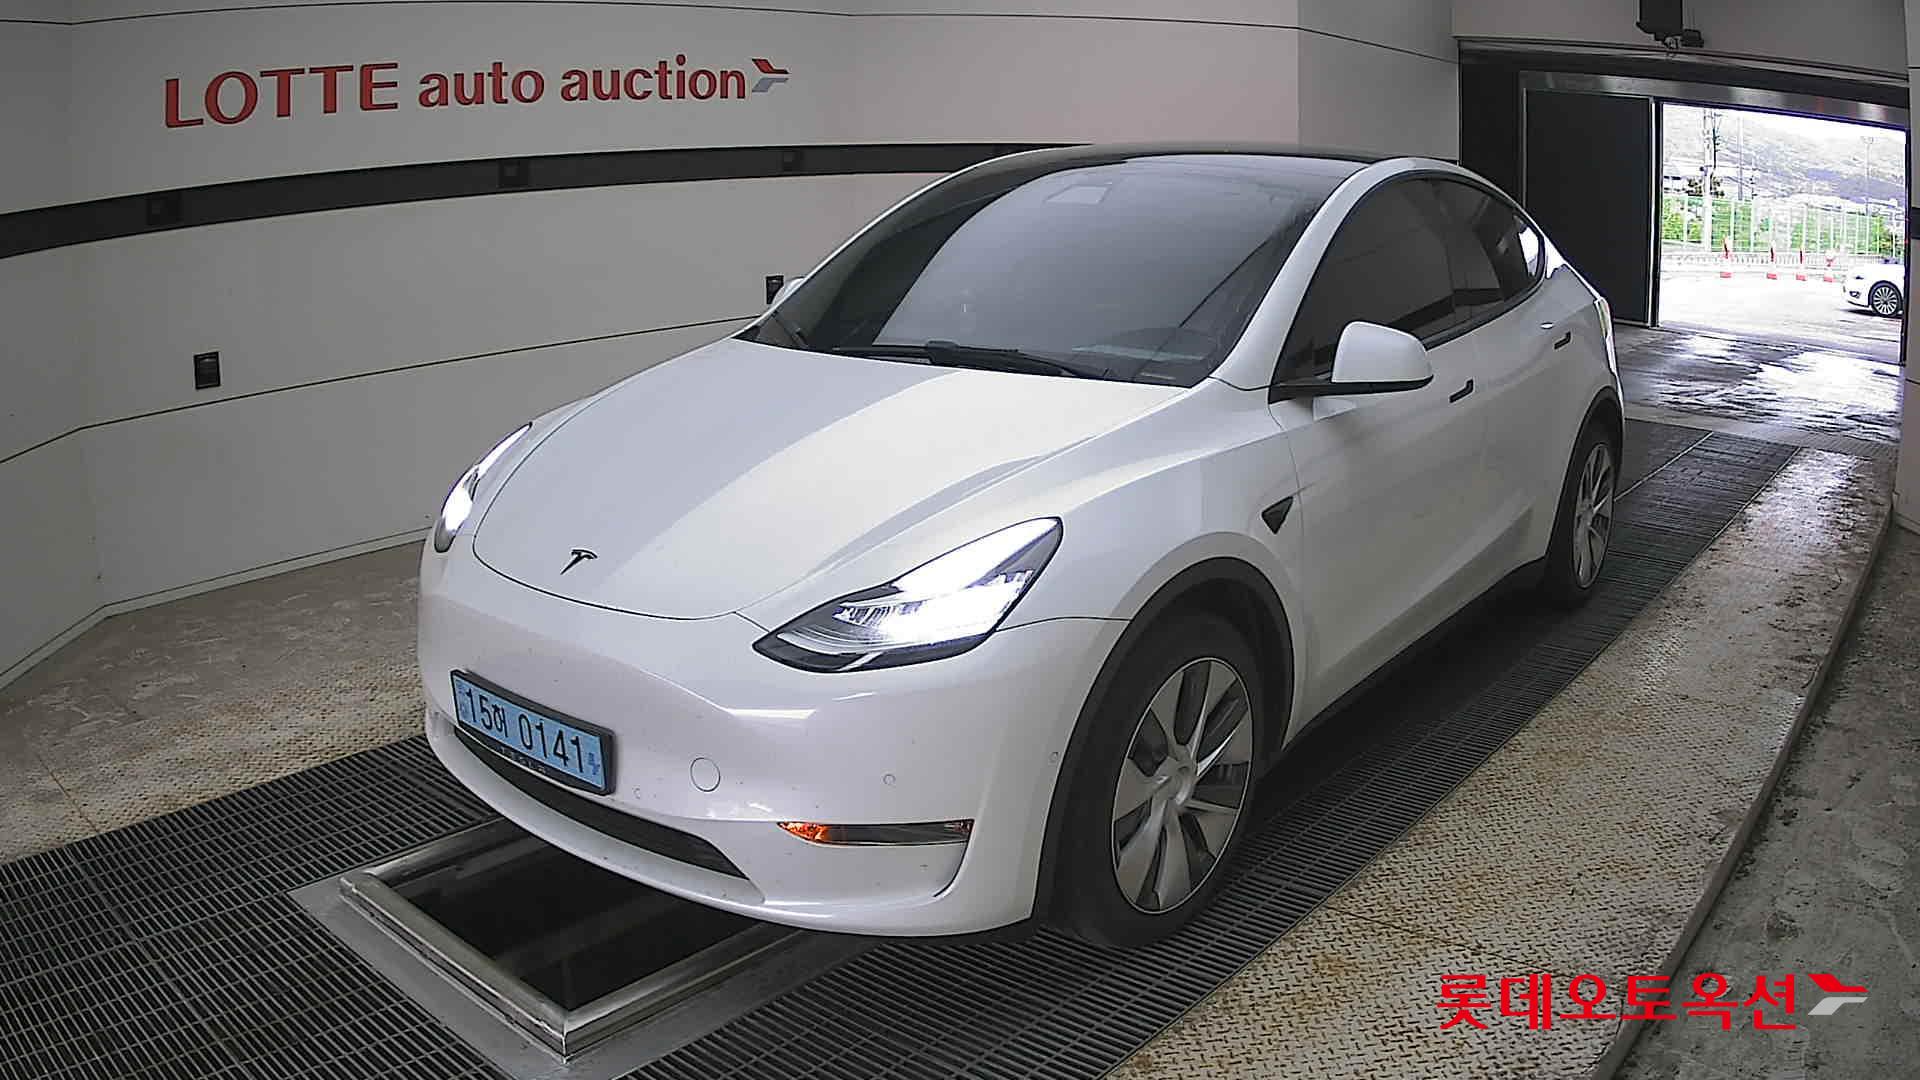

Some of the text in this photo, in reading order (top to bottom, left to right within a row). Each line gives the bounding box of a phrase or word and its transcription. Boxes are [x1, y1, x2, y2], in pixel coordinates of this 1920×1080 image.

[164, 54, 747, 129] LOTTE auto auction
[518, 712, 585, 774] 0141
